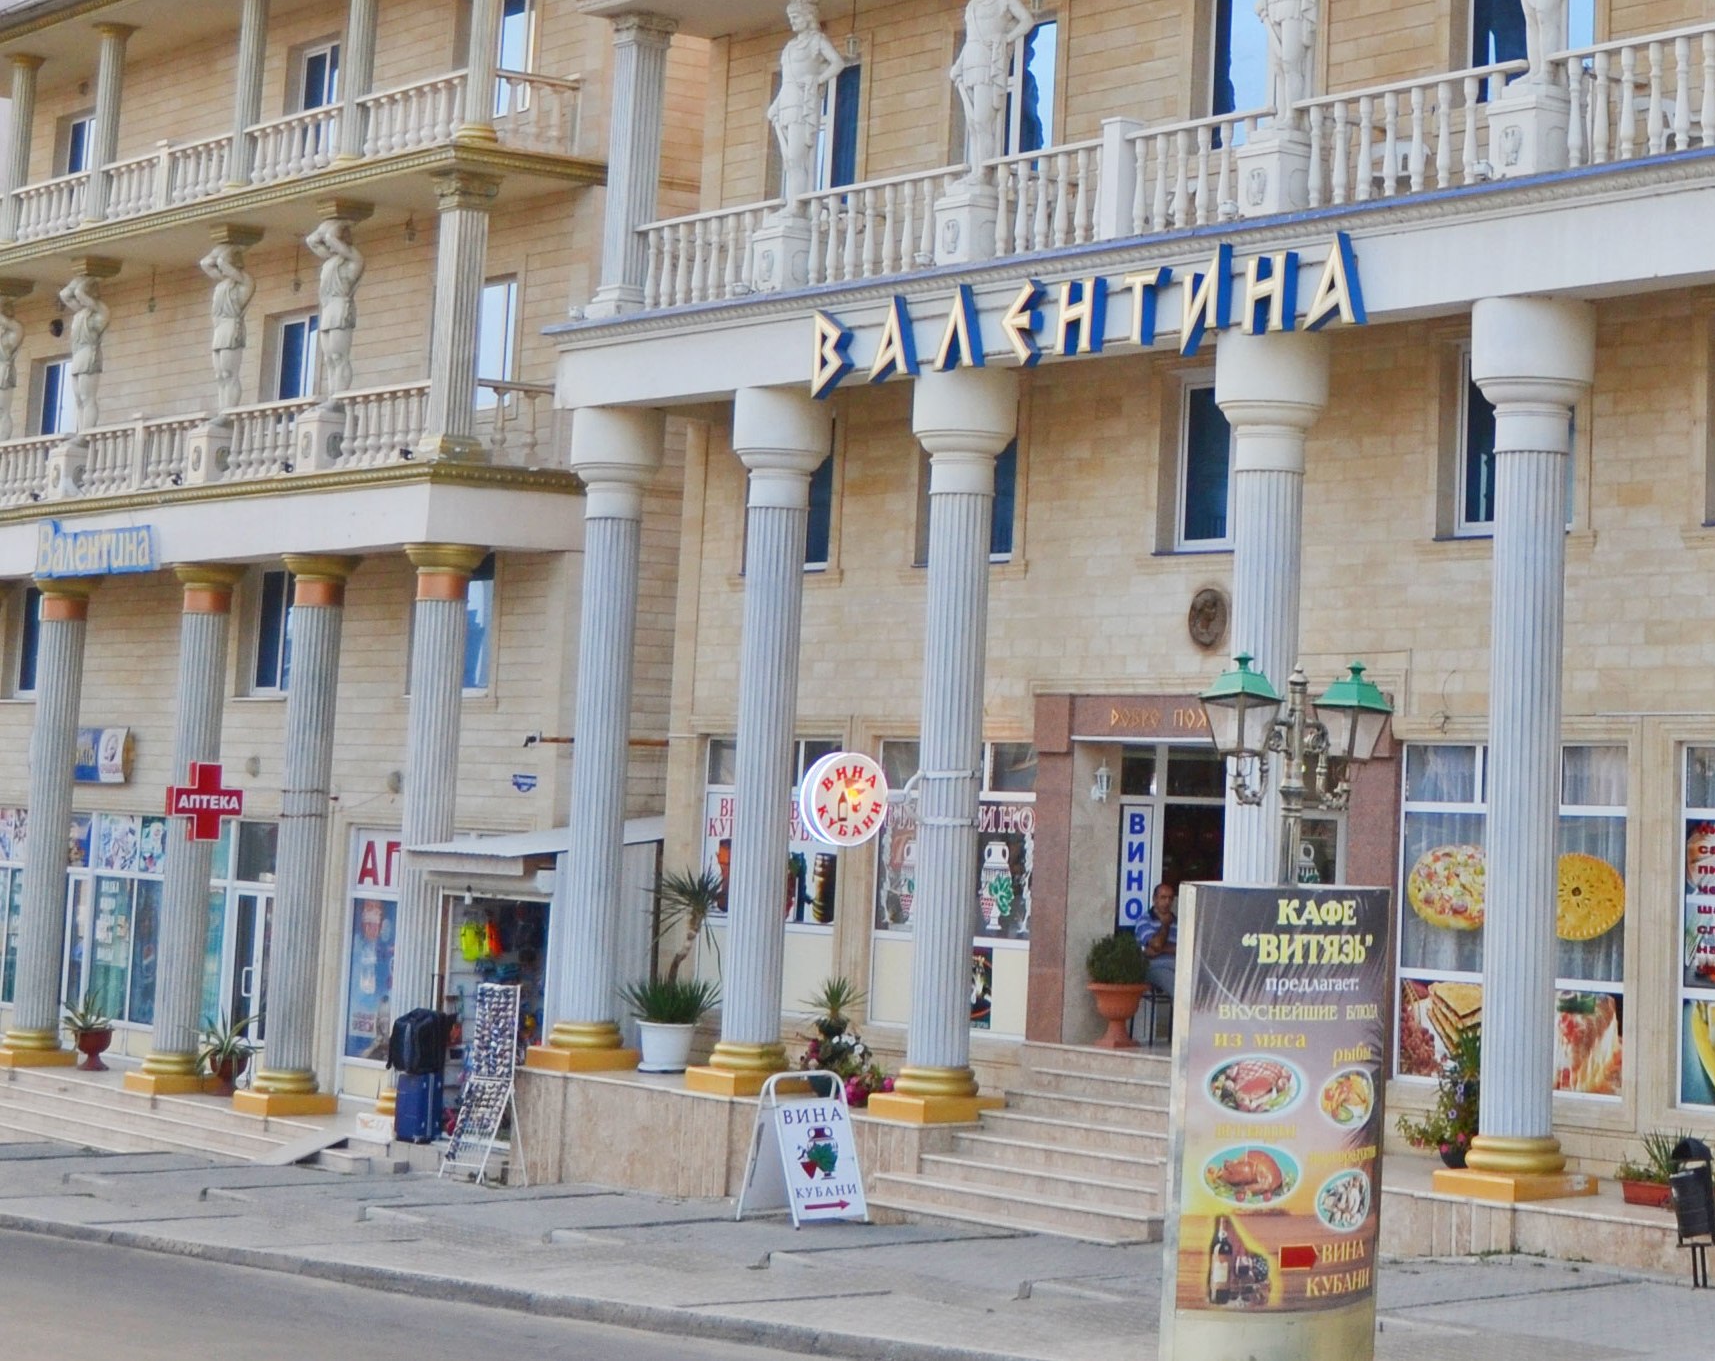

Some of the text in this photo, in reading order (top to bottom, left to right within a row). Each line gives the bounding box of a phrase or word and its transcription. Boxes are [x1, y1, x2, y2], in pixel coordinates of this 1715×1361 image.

[810, 231, 1367, 400] ВАЛЕНТИНА
[38, 524, 151, 574] Валентина
[821, 765, 877, 792] ВИНА
[178, 794, 240, 811] АПТЕКА
[817, 801, 882, 837] КУБАНИ
[1124, 812, 1146, 921] ВИНО
[1277, 899, 1357, 926] КАФЕ
[1265, 977, 1360, 996] предлагает:
[1218, 1001, 1338, 1021] ВКУСНЕЙШИЕ
[783, 1106, 844, 1125] ВИНА
[795, 1183, 857, 1199] КУБАНИ
[1322, 1240, 1365, 1264] ВИНА
[1306, 1268, 1371, 1297] КУБАНИ
